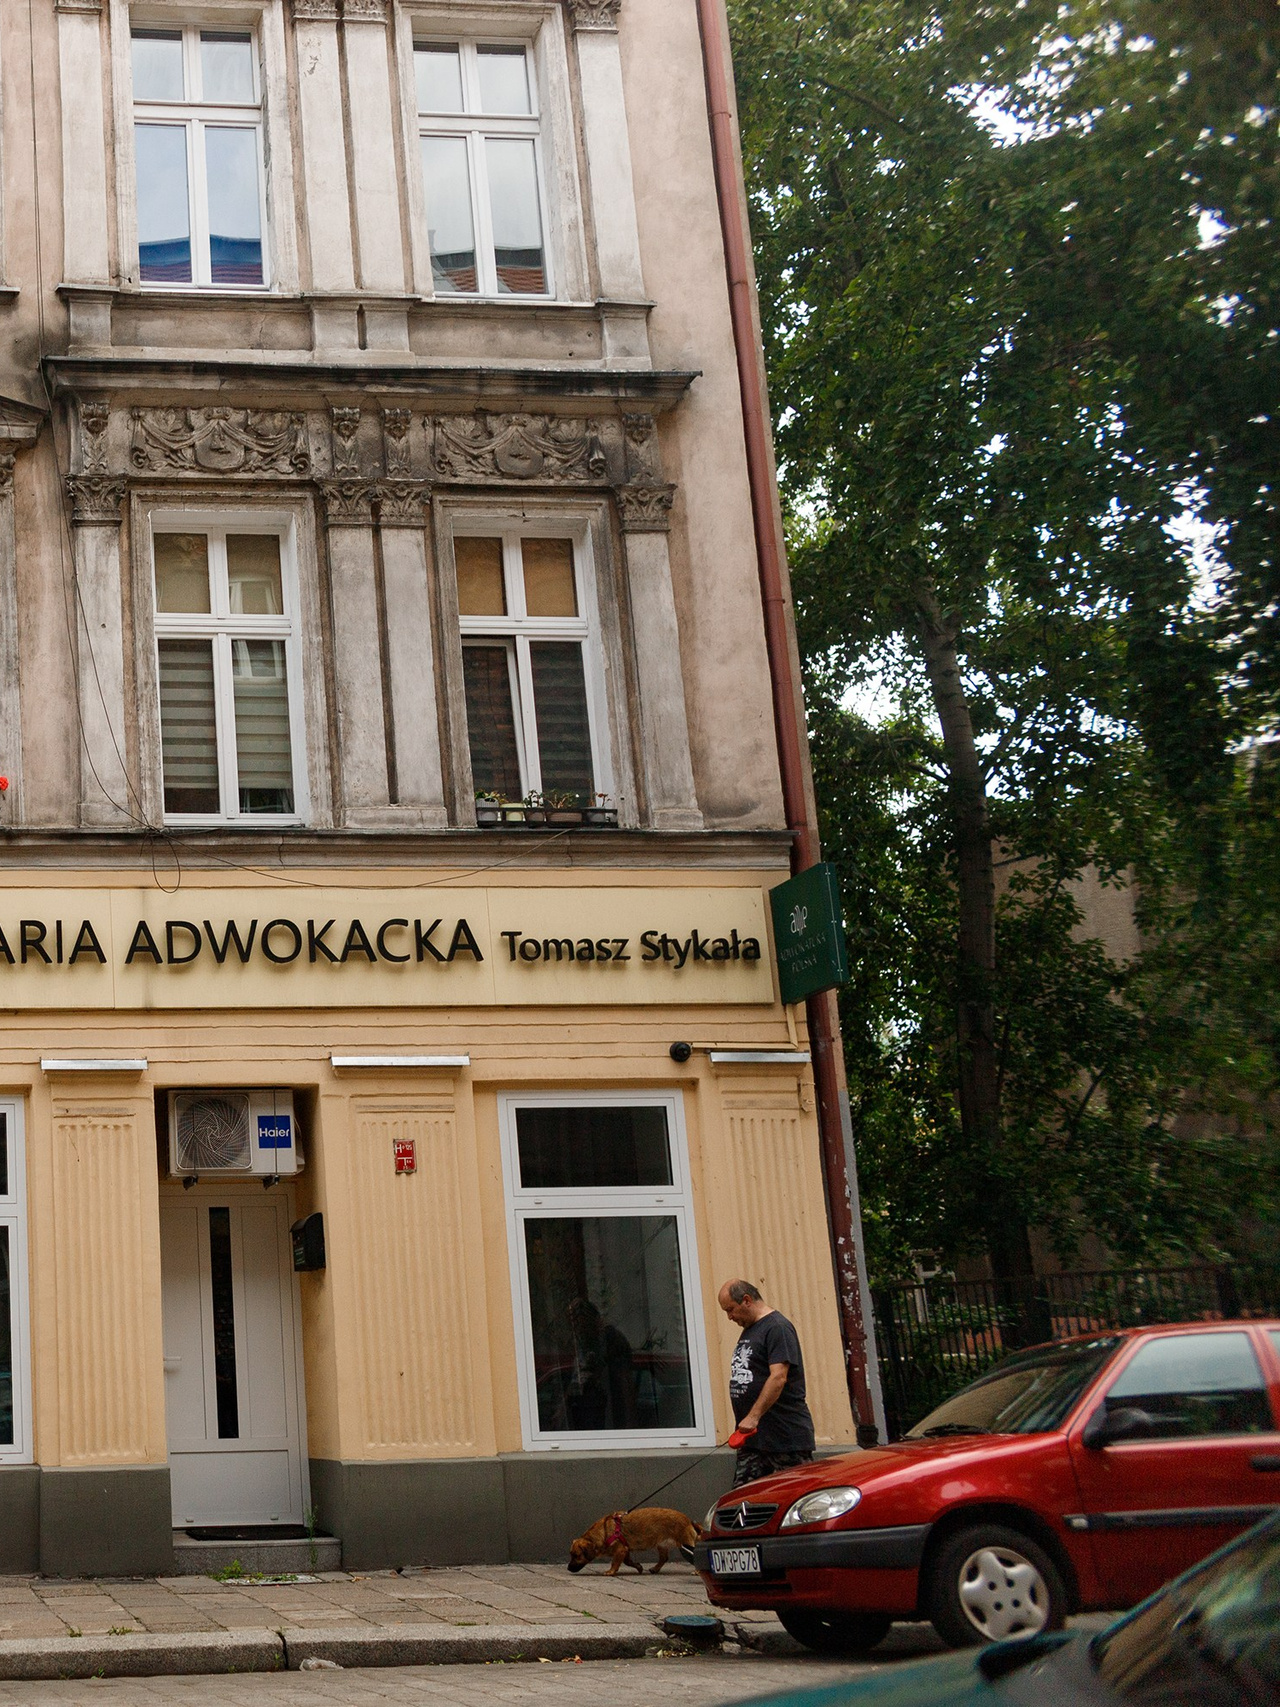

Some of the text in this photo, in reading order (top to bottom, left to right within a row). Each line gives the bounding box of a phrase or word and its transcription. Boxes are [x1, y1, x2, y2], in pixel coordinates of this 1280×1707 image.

[124, 918, 485, 965] ADWOKACKA
[500, 930, 632, 962] Tomasz
[639, 928, 762, 970] Stykała
[259, 1127, 290, 1138] Haier
